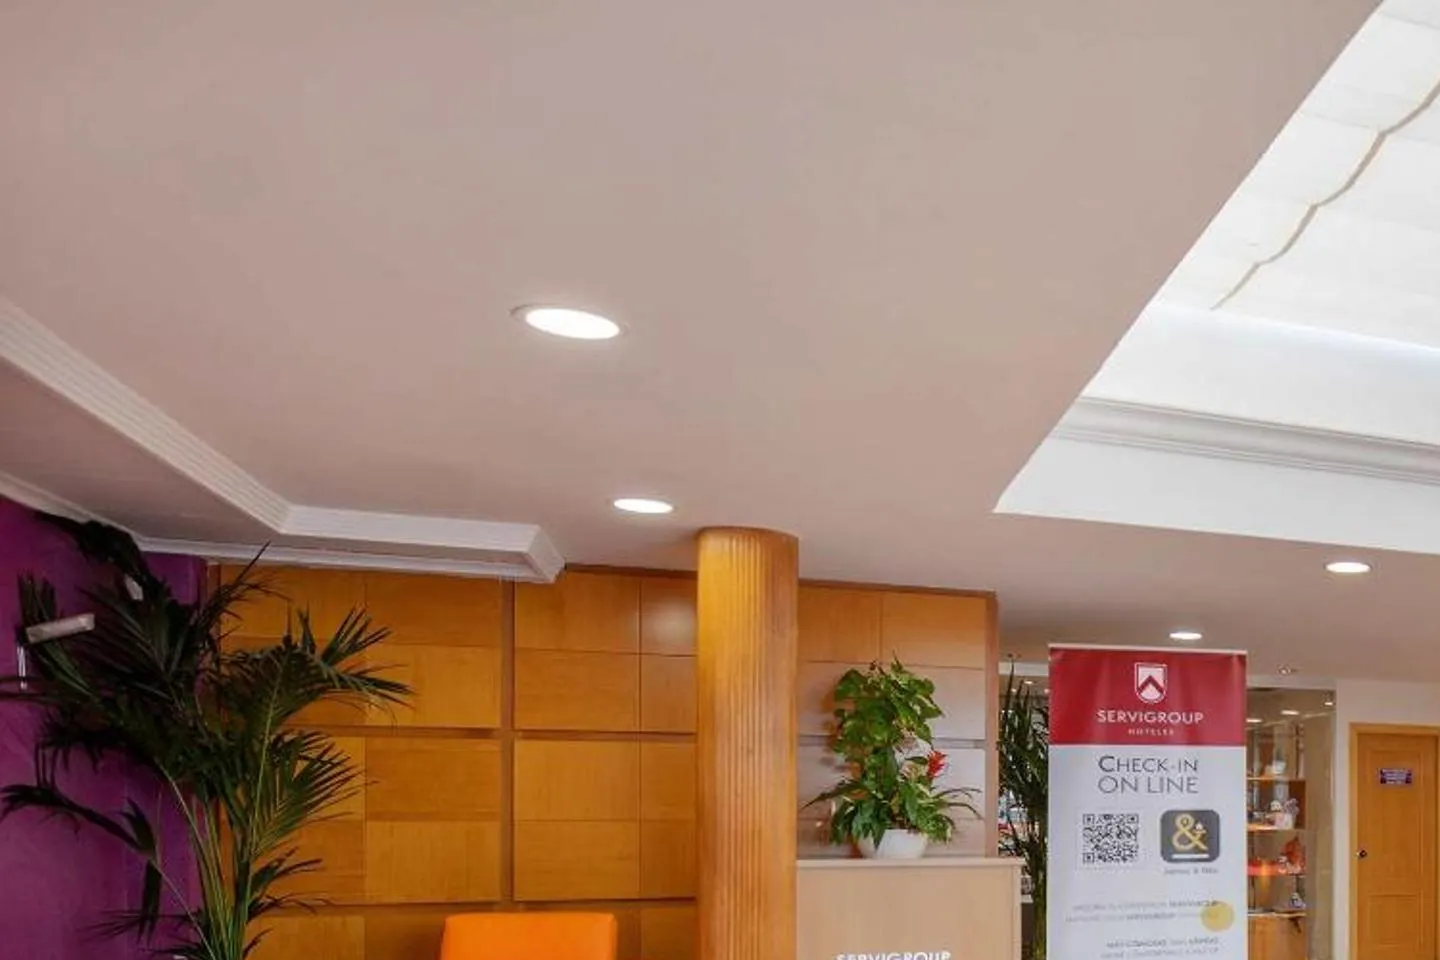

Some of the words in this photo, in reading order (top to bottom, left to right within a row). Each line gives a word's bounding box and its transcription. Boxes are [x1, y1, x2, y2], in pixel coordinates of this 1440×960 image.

[1097, 710, 1204, 725] SERVIGROUP
[1098, 776, 1138, 794] ON
[1147, 776, 1199, 794] LINE
